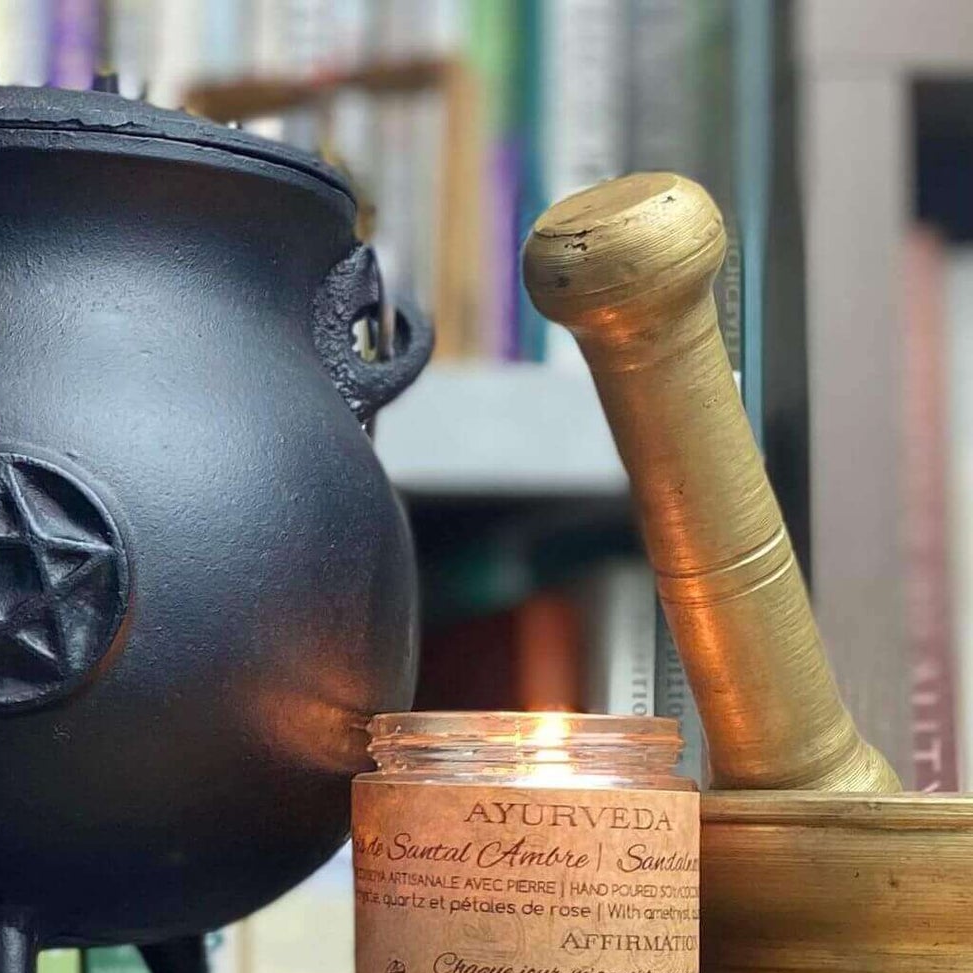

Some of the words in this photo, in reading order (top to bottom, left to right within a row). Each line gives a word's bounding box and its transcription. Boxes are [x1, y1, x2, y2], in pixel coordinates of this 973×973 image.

[463, 801, 674, 831] AYURVEDA
[387, 832, 473, 863] Santal
[477, 836, 591, 869] Ambre
[388, 871, 461, 890] ARTISANALE
[464, 877, 503, 892] AVEC
[507, 879, 557, 895] PIERRE
[570, 881, 609, 897] HAND
[382, 892, 426, 909] quartz
[429, 895, 446, 910] et
[449, 896, 516, 915] pétales
[521, 900, 545, 916] de
[550, 904, 592, 918] rose
[607, 903, 641, 920] With
